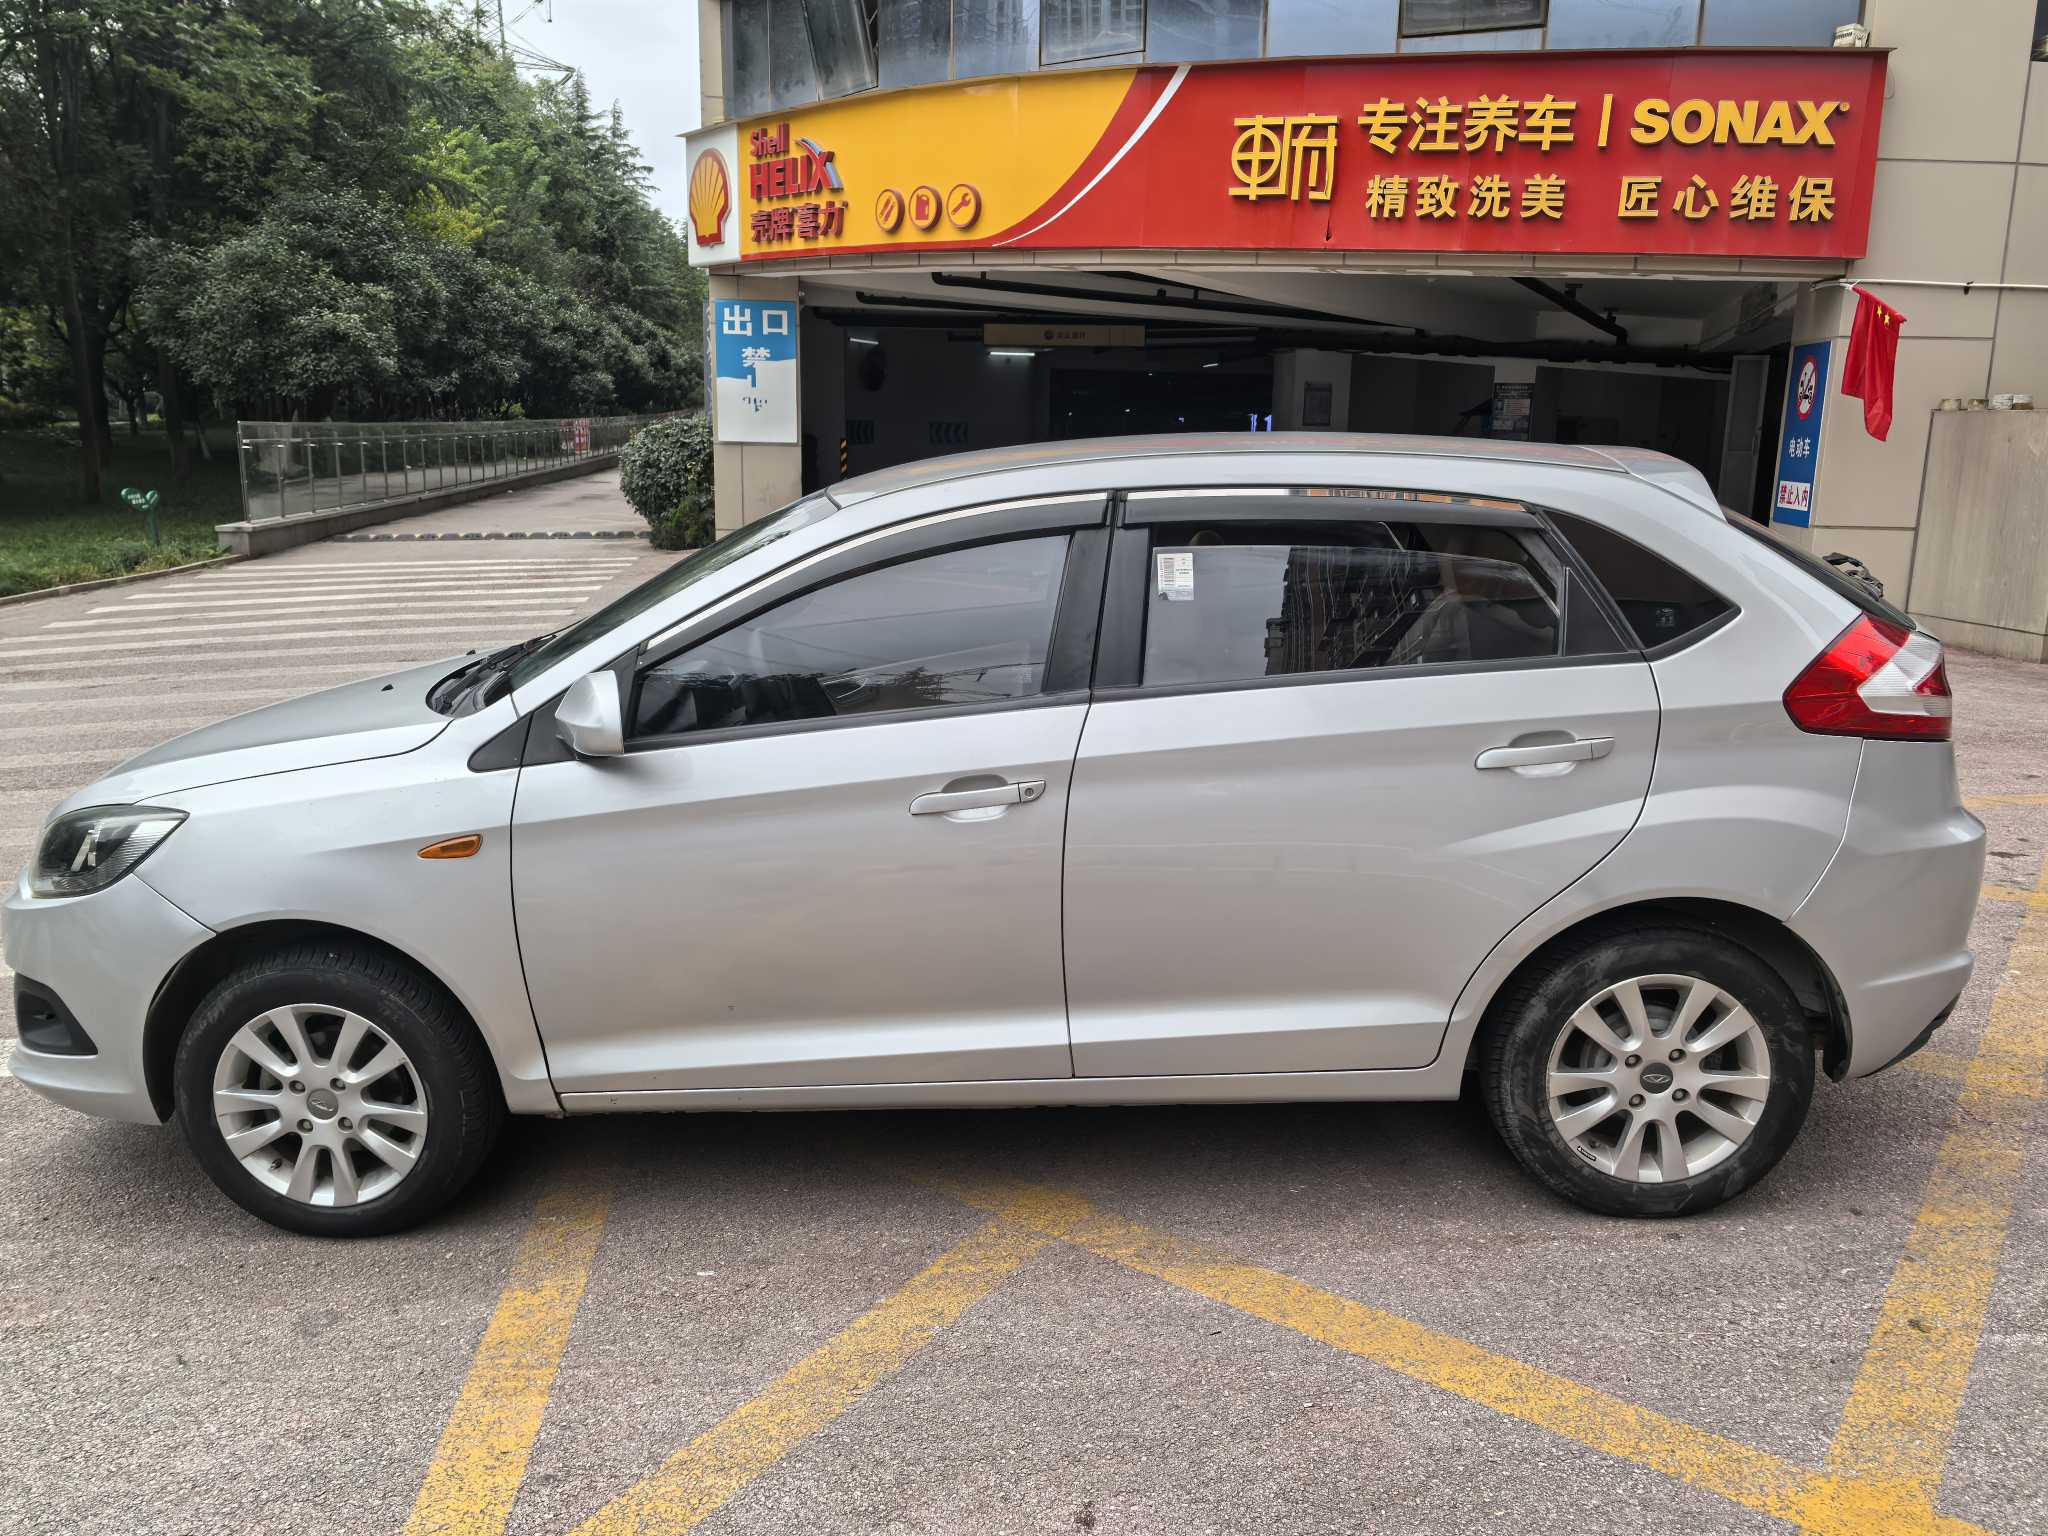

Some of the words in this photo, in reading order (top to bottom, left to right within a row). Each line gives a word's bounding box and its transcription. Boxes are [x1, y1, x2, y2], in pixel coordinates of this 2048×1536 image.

[750, 122, 789, 158] Shell
[1358, 95, 1576, 154] 专注养车
[1631, 100, 1839, 146] SONAX
[750, 143, 843, 200] HELIX
[1365, 175, 1567, 221] 精致洗美
[1616, 174, 1836, 223] 匠心维保
[722, 304, 789, 336] 出口
[1789, 437, 1810, 459] 电动车
[1779, 484, 1809, 507] 禁止入内
